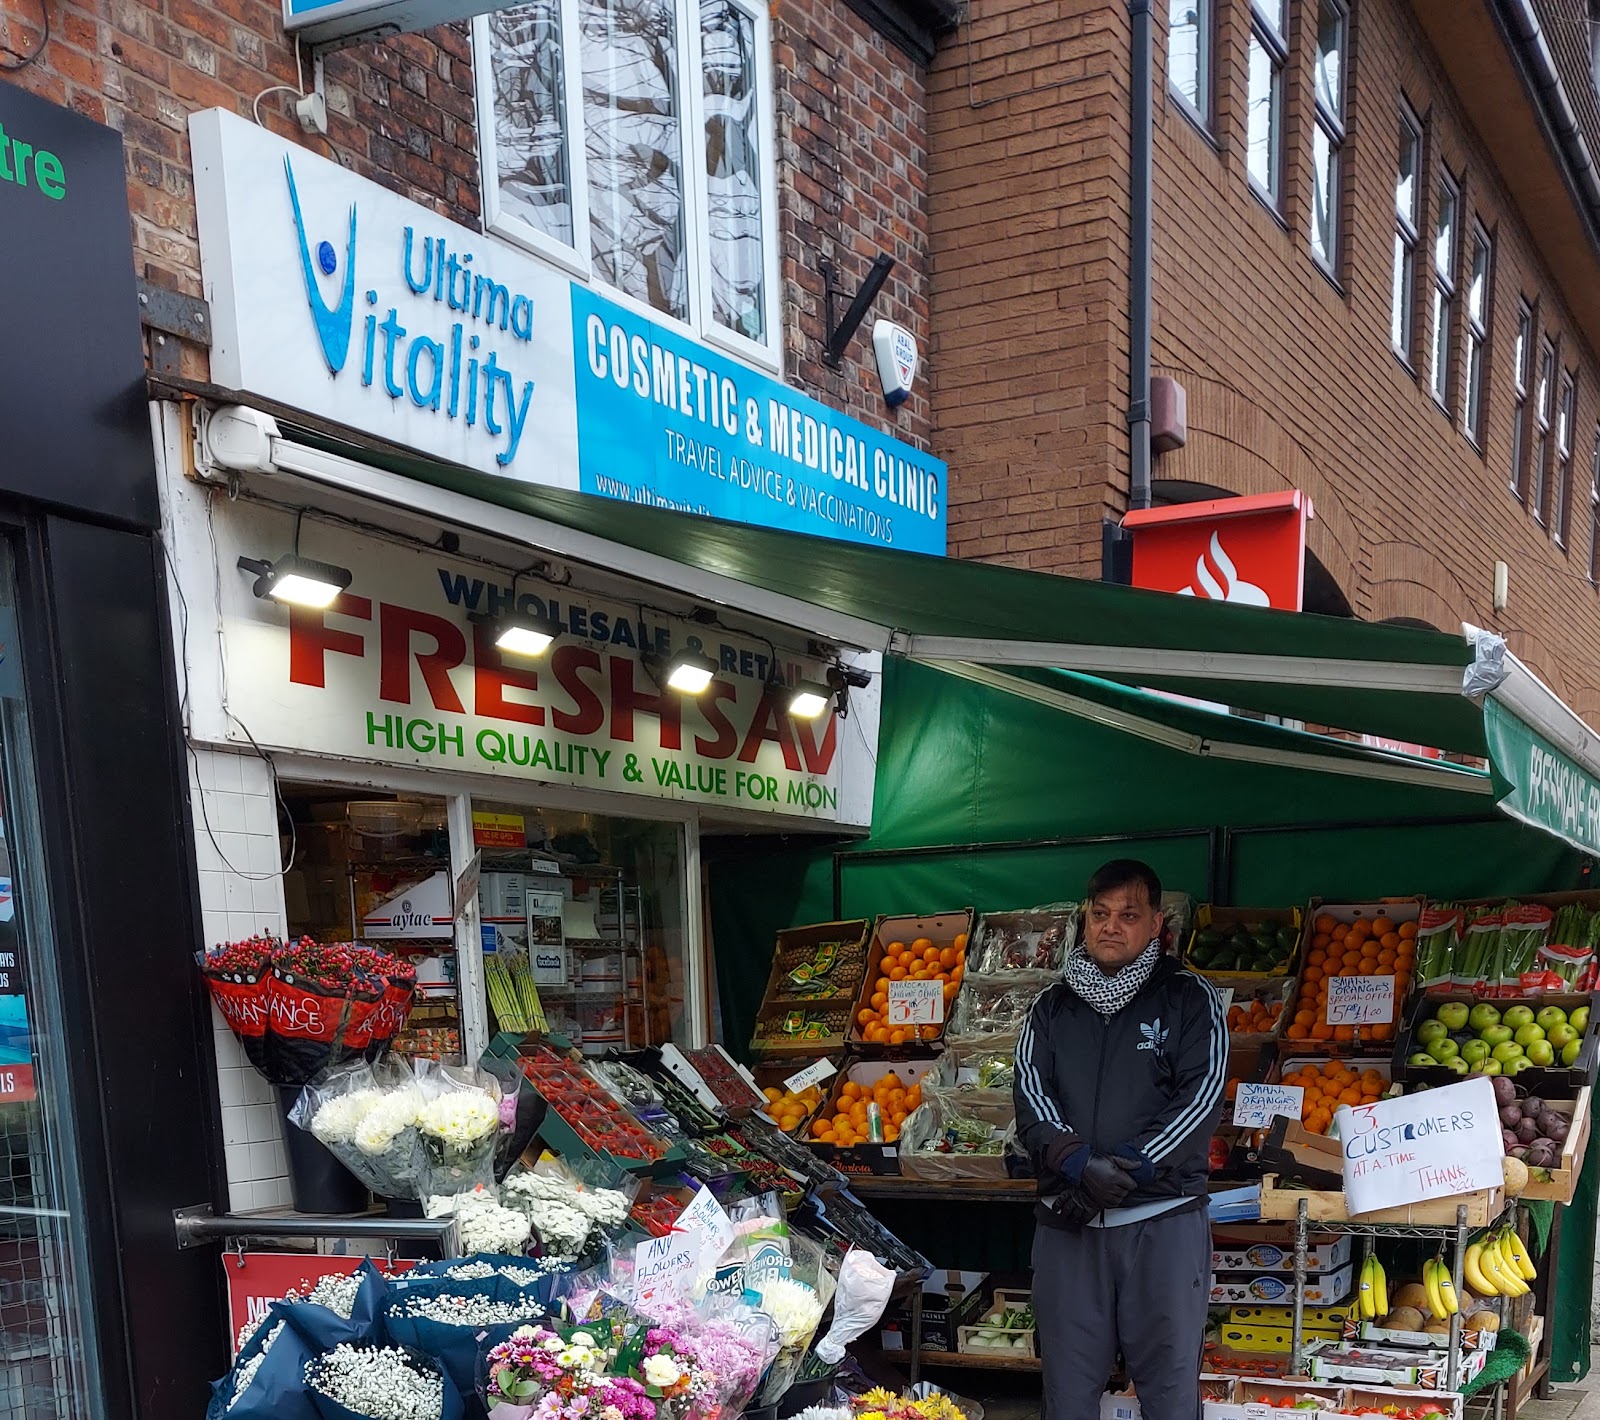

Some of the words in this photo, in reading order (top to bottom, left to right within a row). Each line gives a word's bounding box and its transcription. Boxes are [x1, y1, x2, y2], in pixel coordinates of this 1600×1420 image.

[403, 226, 534, 342] Ultima
[586, 313, 739, 436] COSMETIC
[745, 397, 764, 447] &
[769, 399, 870, 493] MEDICAL
[873, 446, 939, 521] CLINIC
[665, 428, 726, 480] TRAVEL
[730, 455, 783, 503] ADVICE
[785, 479, 797, 506] &
[799, 482, 893, 544] VACCINATIONS
[437, 569, 671, 656] WHOLESALE
[365, 712, 464, 758] HIGH
[475, 728, 611, 780] QUALITY
[623, 753, 643, 783] &
[652, 759, 728, 797] VALUE
[735, 772, 778, 803] FOR
[786, 778, 838, 811] MON
[392, 911, 431, 931] aytac
[1335, 981, 1390, 996] ORANGES
[638, 1250, 691, 1282] FLOWERS
[647, 1234, 674, 1261] ANY
